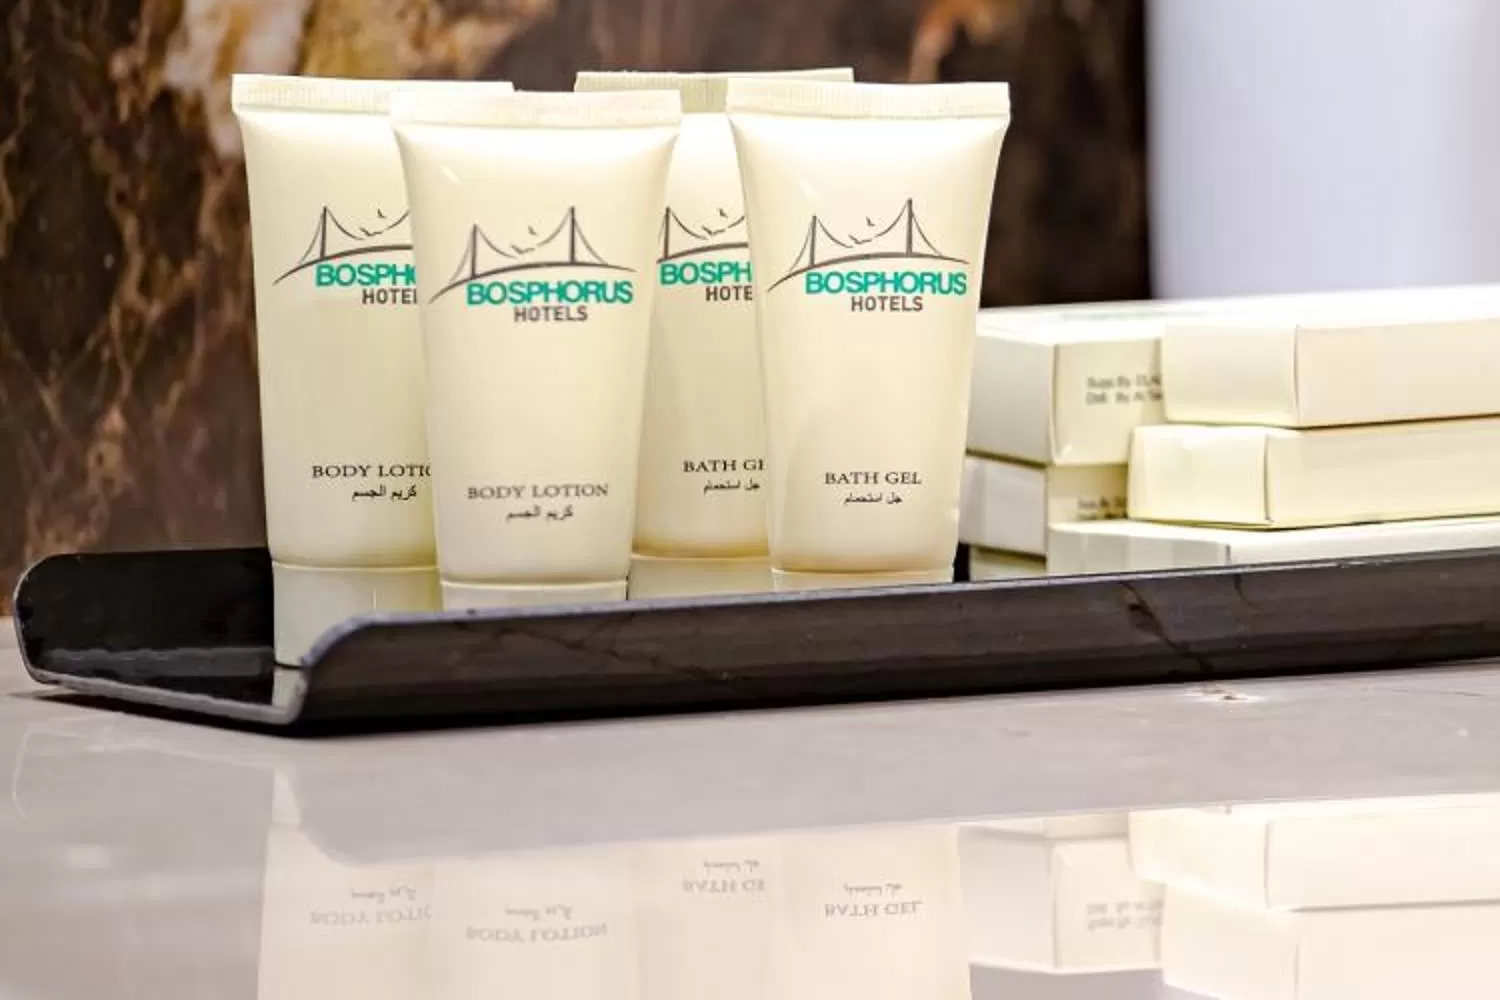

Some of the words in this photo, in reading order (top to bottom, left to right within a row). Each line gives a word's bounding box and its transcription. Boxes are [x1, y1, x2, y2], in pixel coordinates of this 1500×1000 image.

[660, 261, 752, 285] BOSPH
[805, 272, 968, 295] BOSPHORUS
[466, 281, 633, 305] BOSPHORUS
[705, 286, 753, 302] HOTE
[851, 296, 923, 312] HOTELS
[513, 306, 588, 322] HOTELS
[312, 464, 371, 478] BODY
[683, 459, 737, 473] BATH
[824, 472, 880, 485] BATH
[884, 471, 922, 484] GEL
[391, 485, 417, 500] كريم
[467, 486, 526, 499] BODY
[531, 483, 609, 498] LOTION
